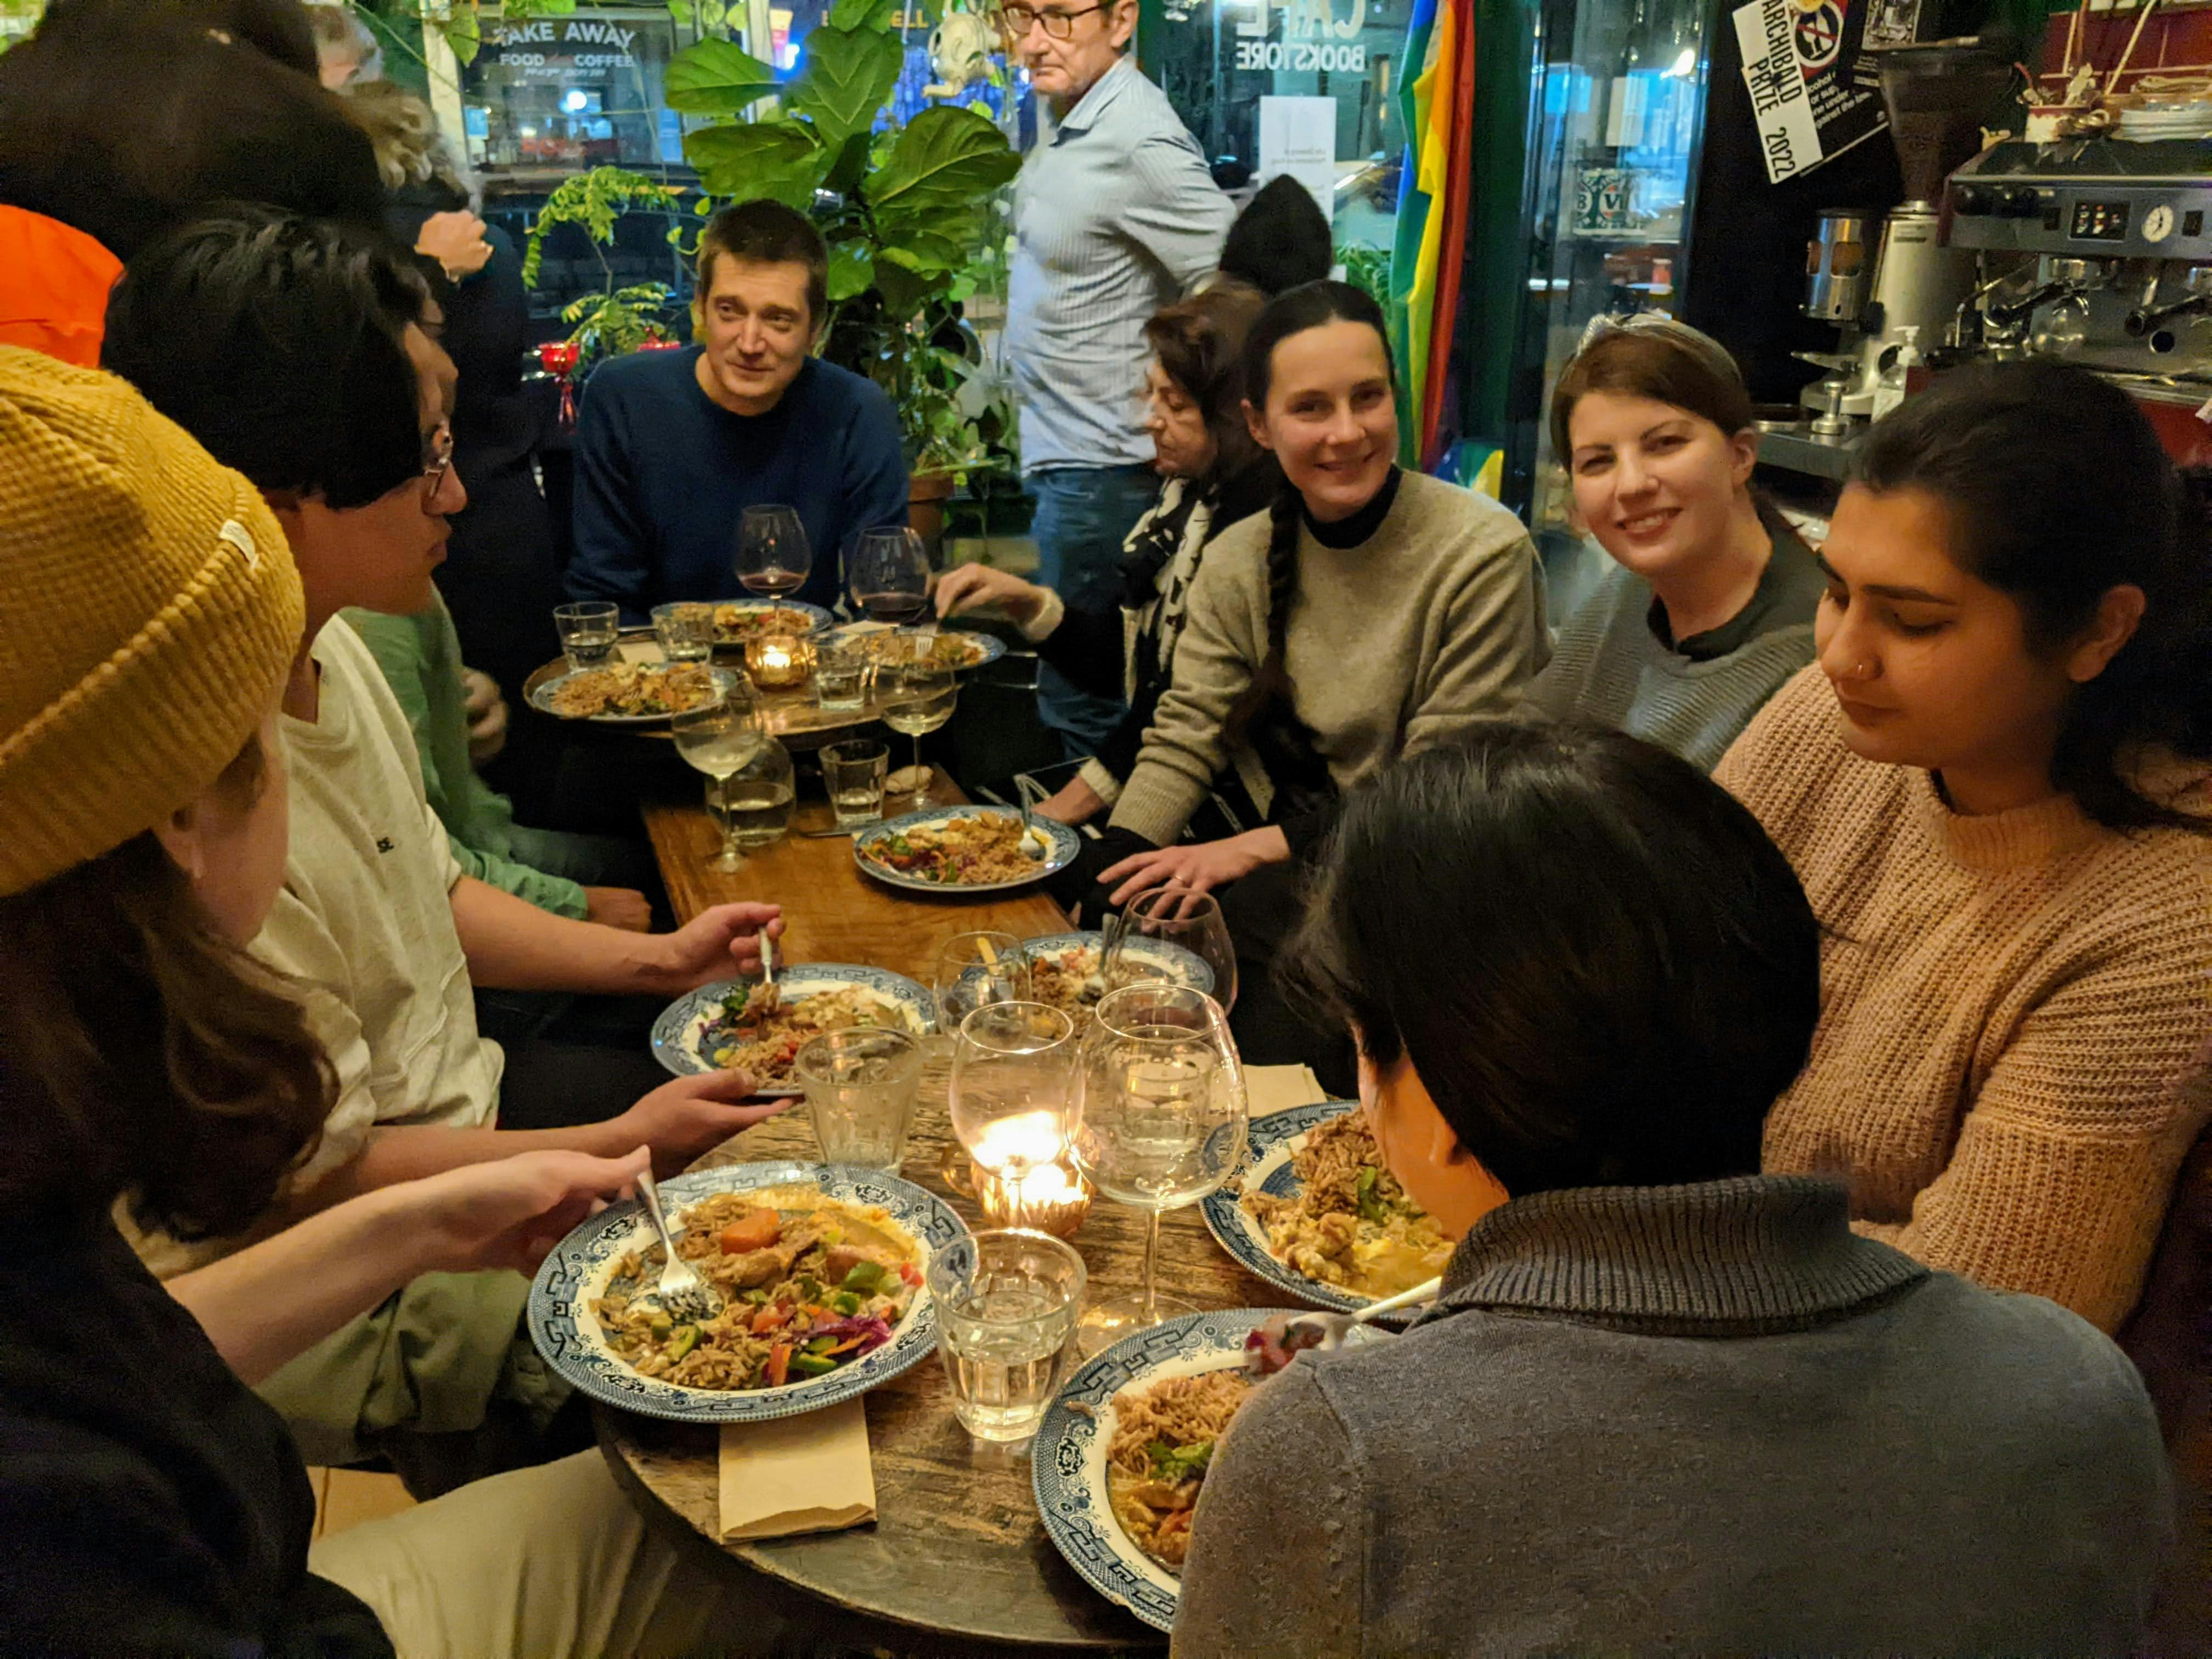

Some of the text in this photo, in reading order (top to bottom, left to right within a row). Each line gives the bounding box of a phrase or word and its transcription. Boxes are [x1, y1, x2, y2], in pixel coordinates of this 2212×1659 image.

[565, 21, 635, 48] AWAY
[1762, 0, 1802, 104] ARCHIBALD
[500, 54, 634, 67] FOOD COFFEE
[1748, 57, 1780, 116] PRIZE
[1765, 127, 1796, 178] 2022
